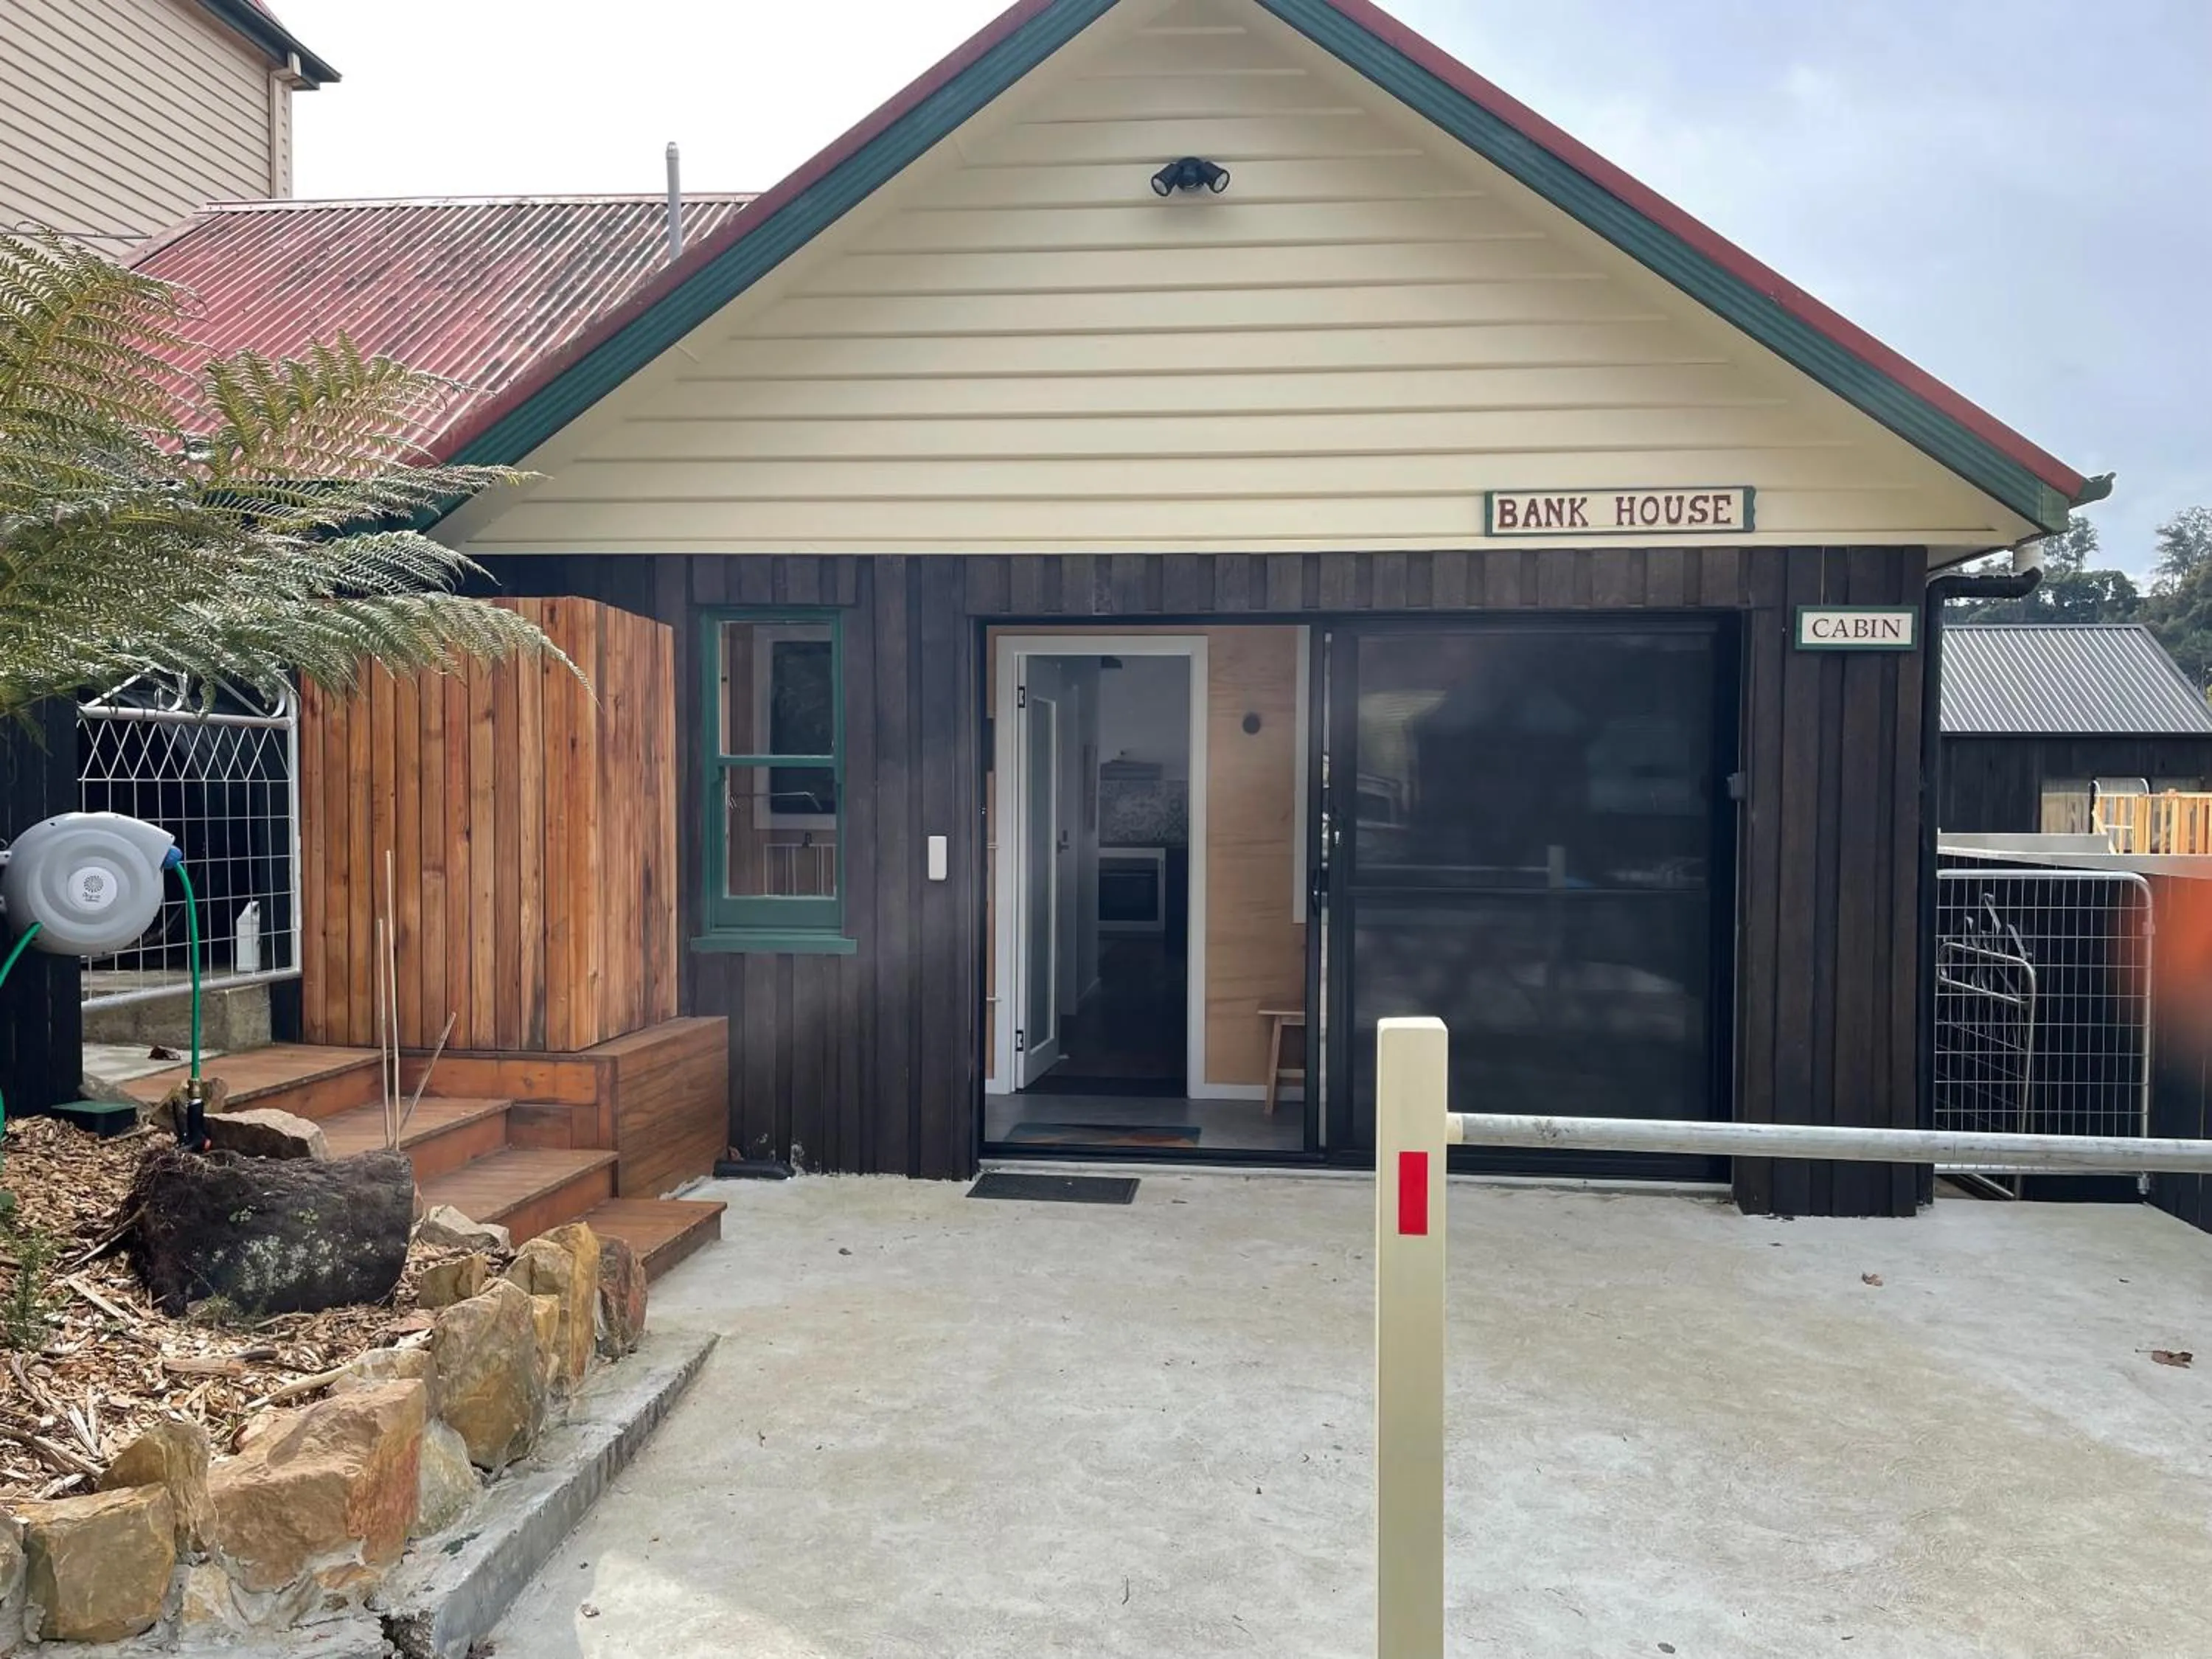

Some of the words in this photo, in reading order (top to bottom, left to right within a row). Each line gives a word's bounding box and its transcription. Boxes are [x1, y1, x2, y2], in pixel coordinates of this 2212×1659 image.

[1498, 497, 1589, 528] BANK
[1615, 495, 1731, 526] HOUSE
[1812, 618, 1901, 639] CABIN
